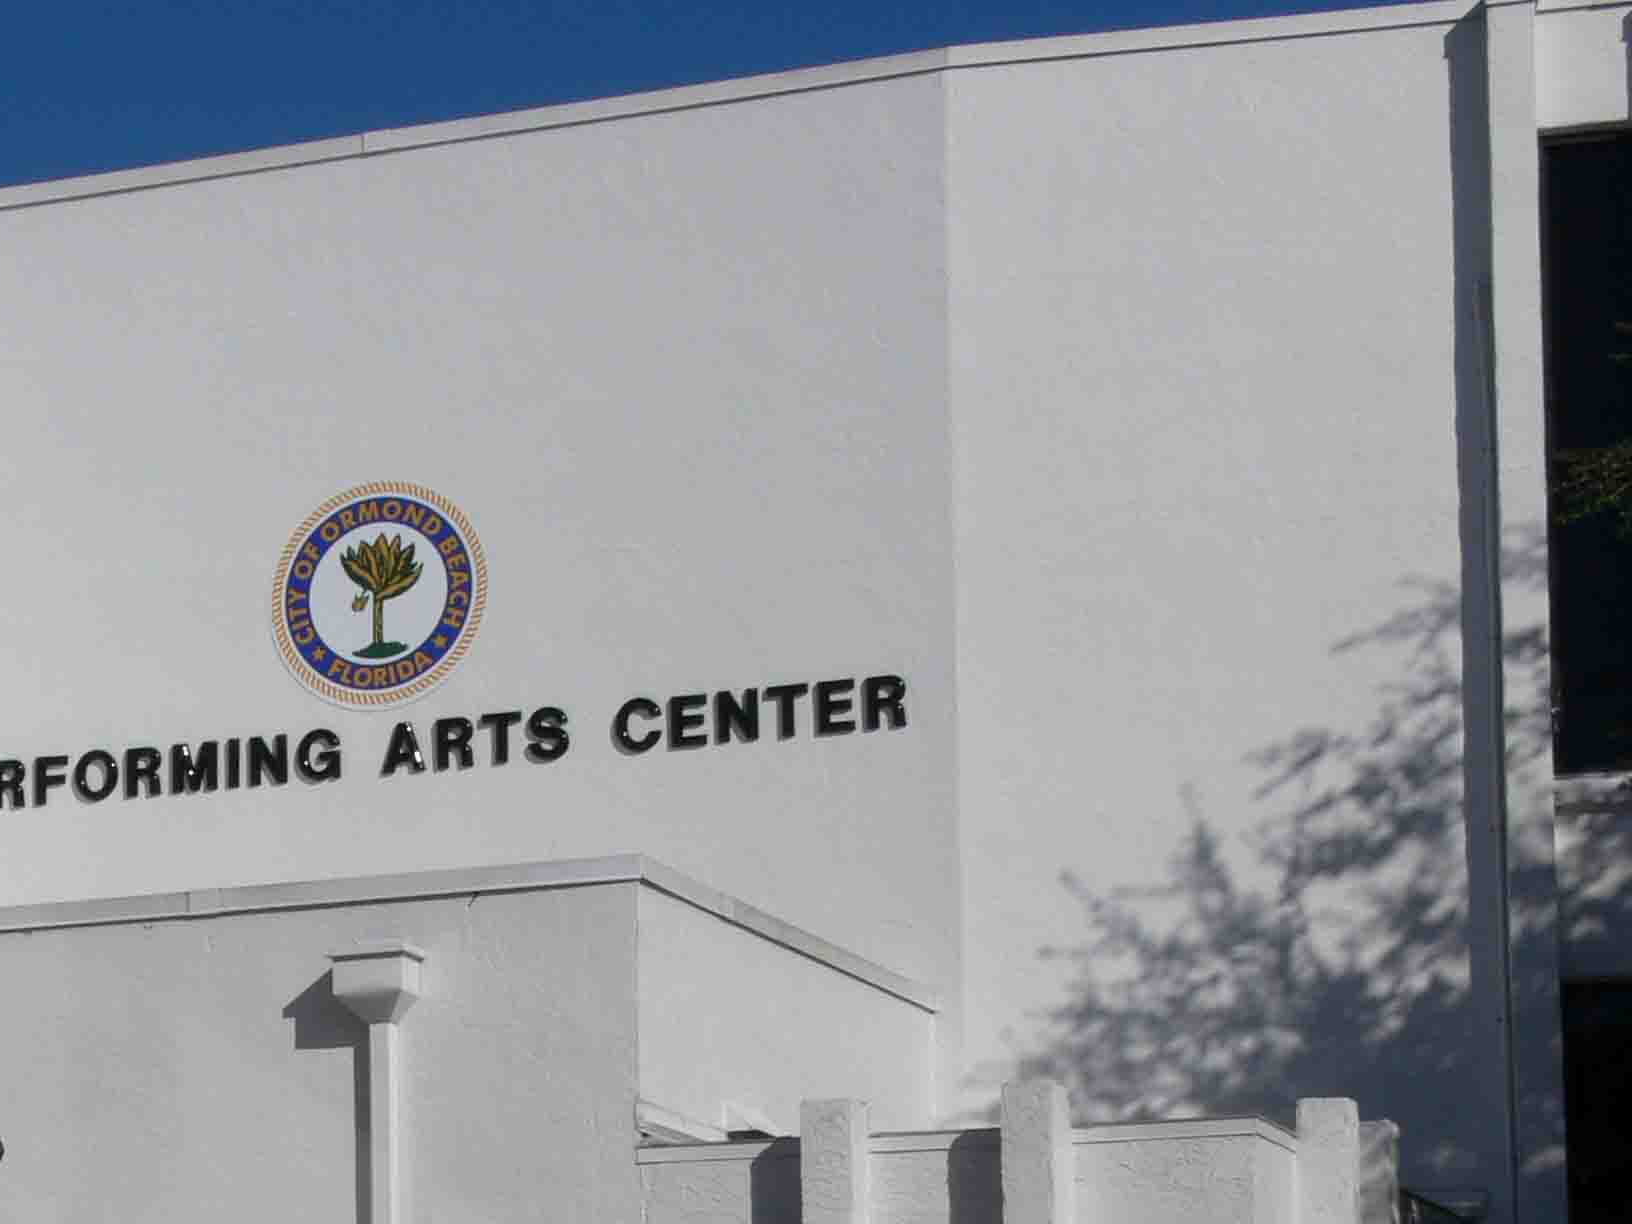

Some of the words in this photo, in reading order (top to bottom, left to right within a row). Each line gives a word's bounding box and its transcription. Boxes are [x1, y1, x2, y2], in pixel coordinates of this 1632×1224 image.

[321, 501, 442, 542] ORMOND
[294, 542, 320, 579] OF
[438, 534, 470, 628] BEACH
[288, 588, 316, 645] CITY
[328, 651, 433, 686] FLORIDA
[380, 707, 569, 777] ARTS
[611, 675, 908, 756] CENTER
